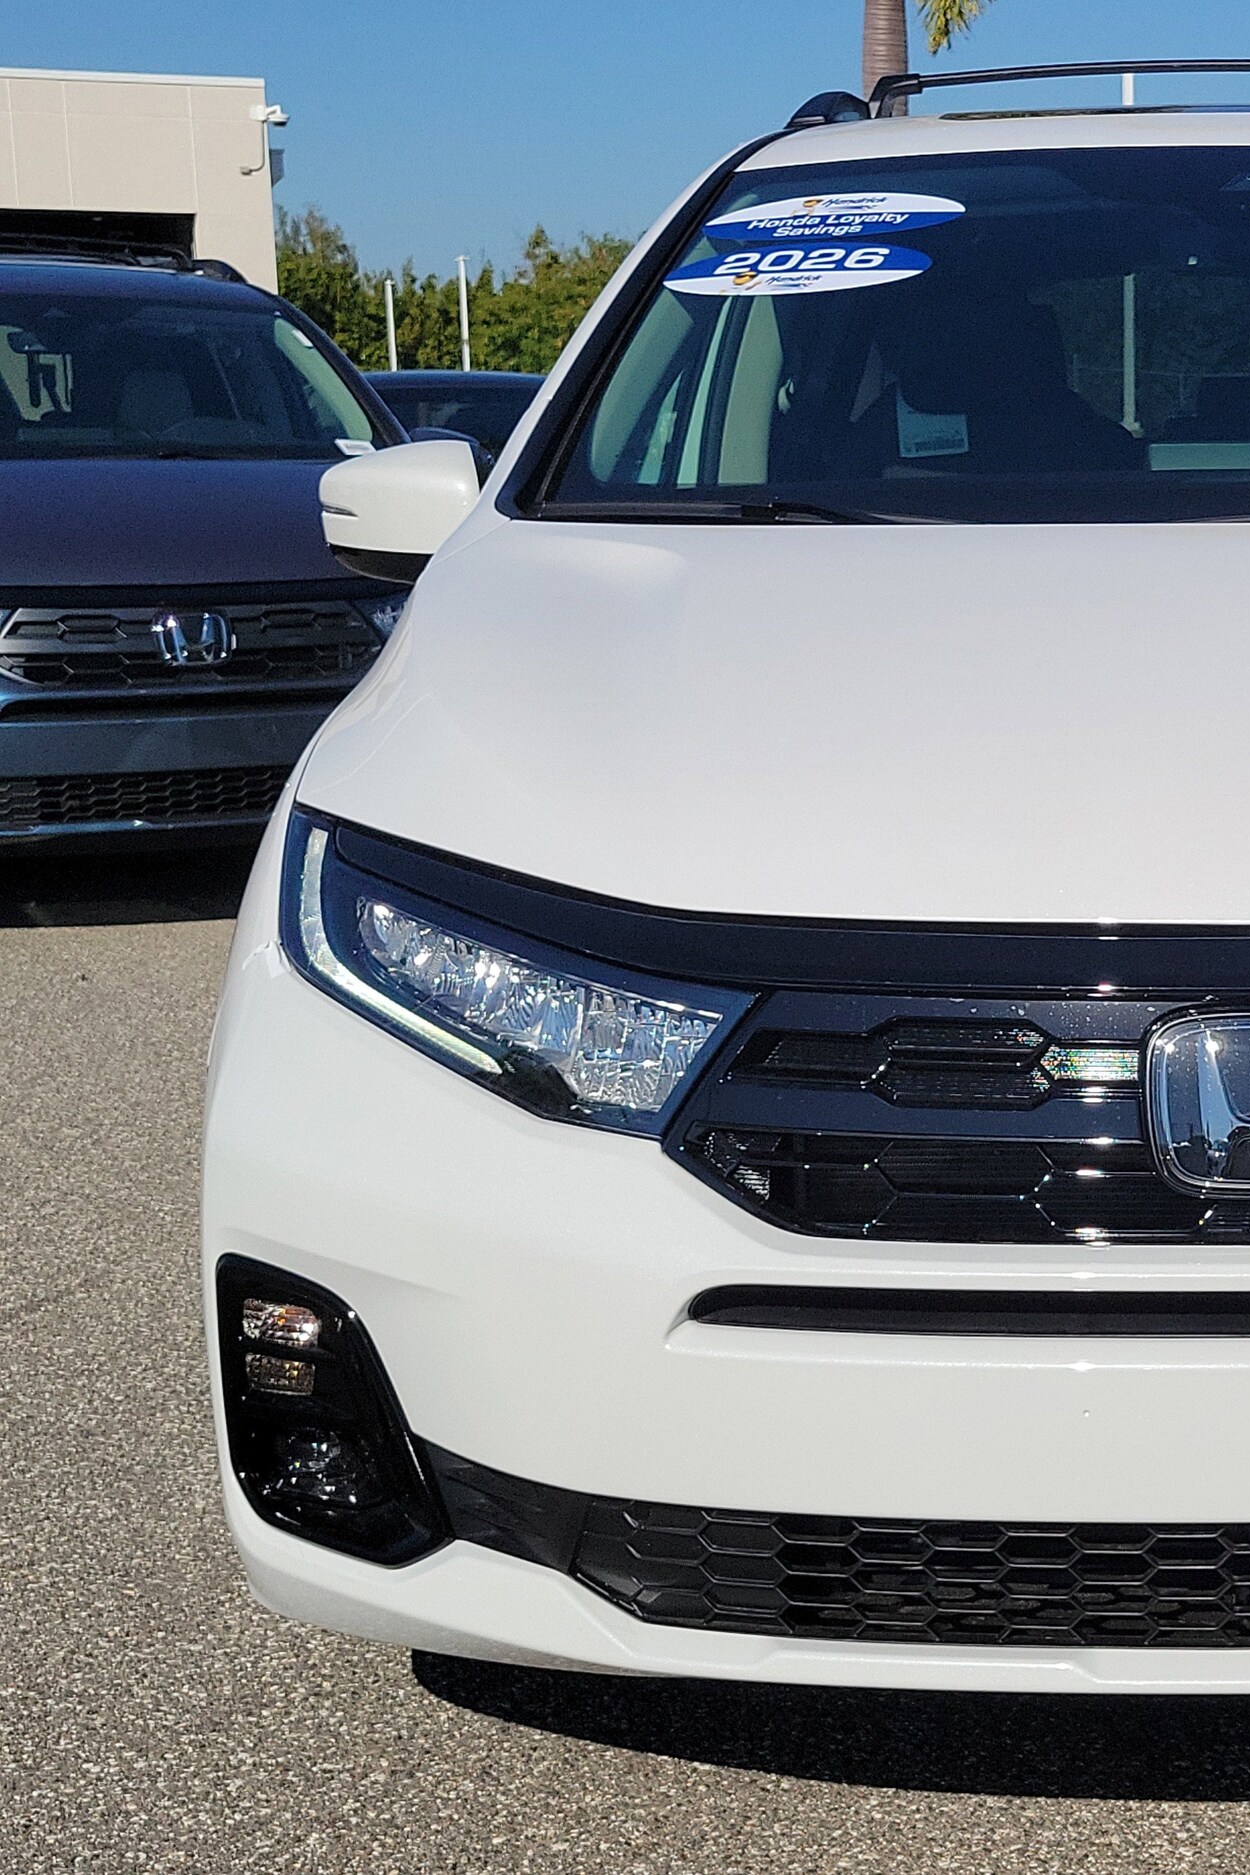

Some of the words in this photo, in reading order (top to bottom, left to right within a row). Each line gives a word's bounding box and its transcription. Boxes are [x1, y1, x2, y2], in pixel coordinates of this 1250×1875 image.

[746, 213, 822, 231] Honda
[825, 211, 910, 225] Loyalty
[772, 223, 864, 237] Savings
[712, 247, 891, 275] 2026
